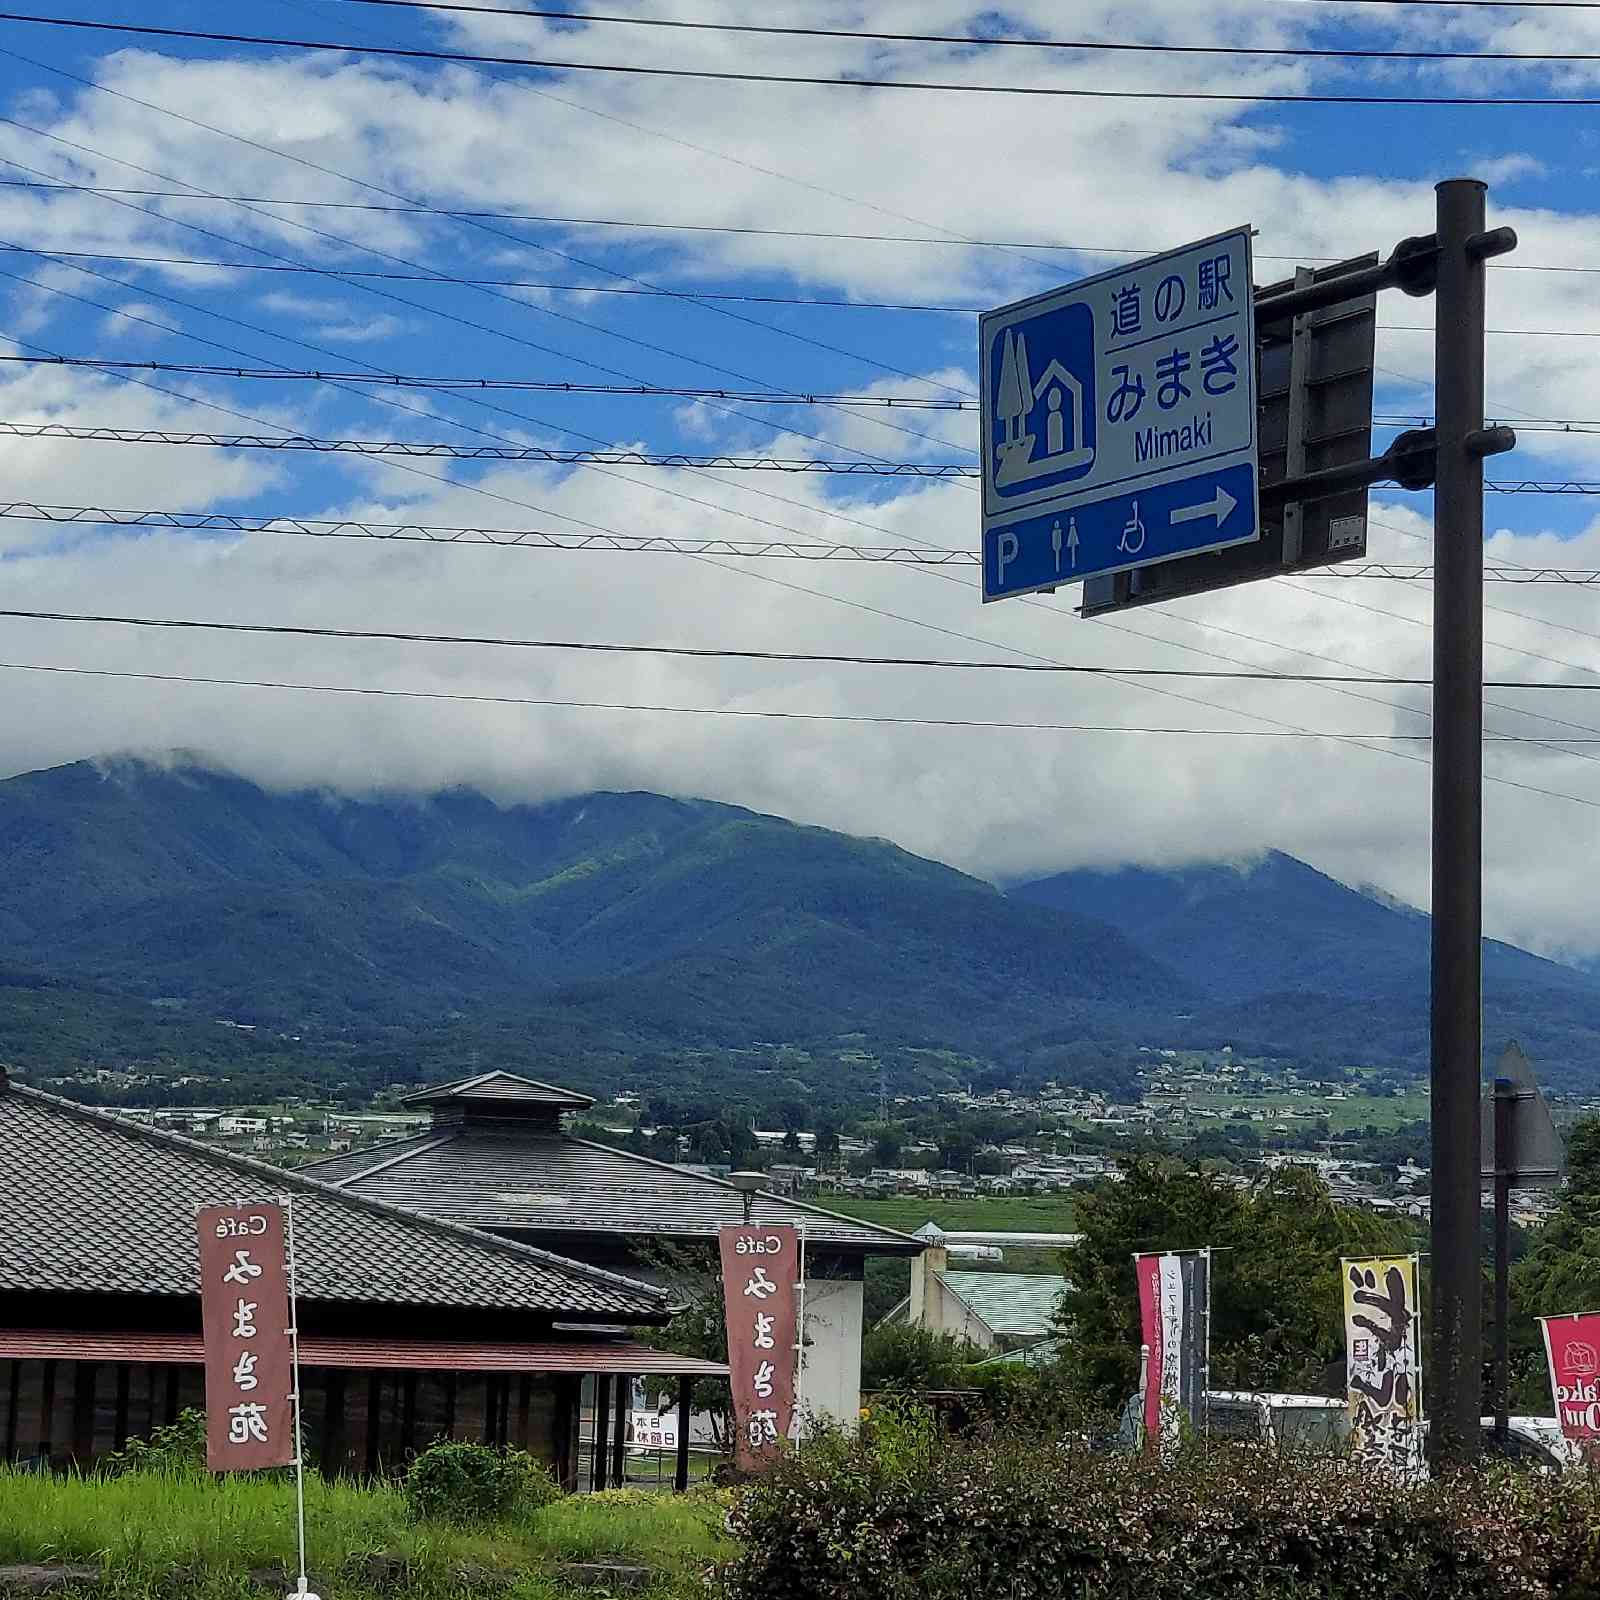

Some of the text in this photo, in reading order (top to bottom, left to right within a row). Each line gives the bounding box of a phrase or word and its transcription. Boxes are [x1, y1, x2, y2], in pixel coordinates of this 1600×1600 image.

[1110, 253, 1234, 338] 道の駅
[1106, 333, 1240, 422] みまき
[1134, 412, 1213, 463] Mimaki
[997, 533, 1019, 585] P
